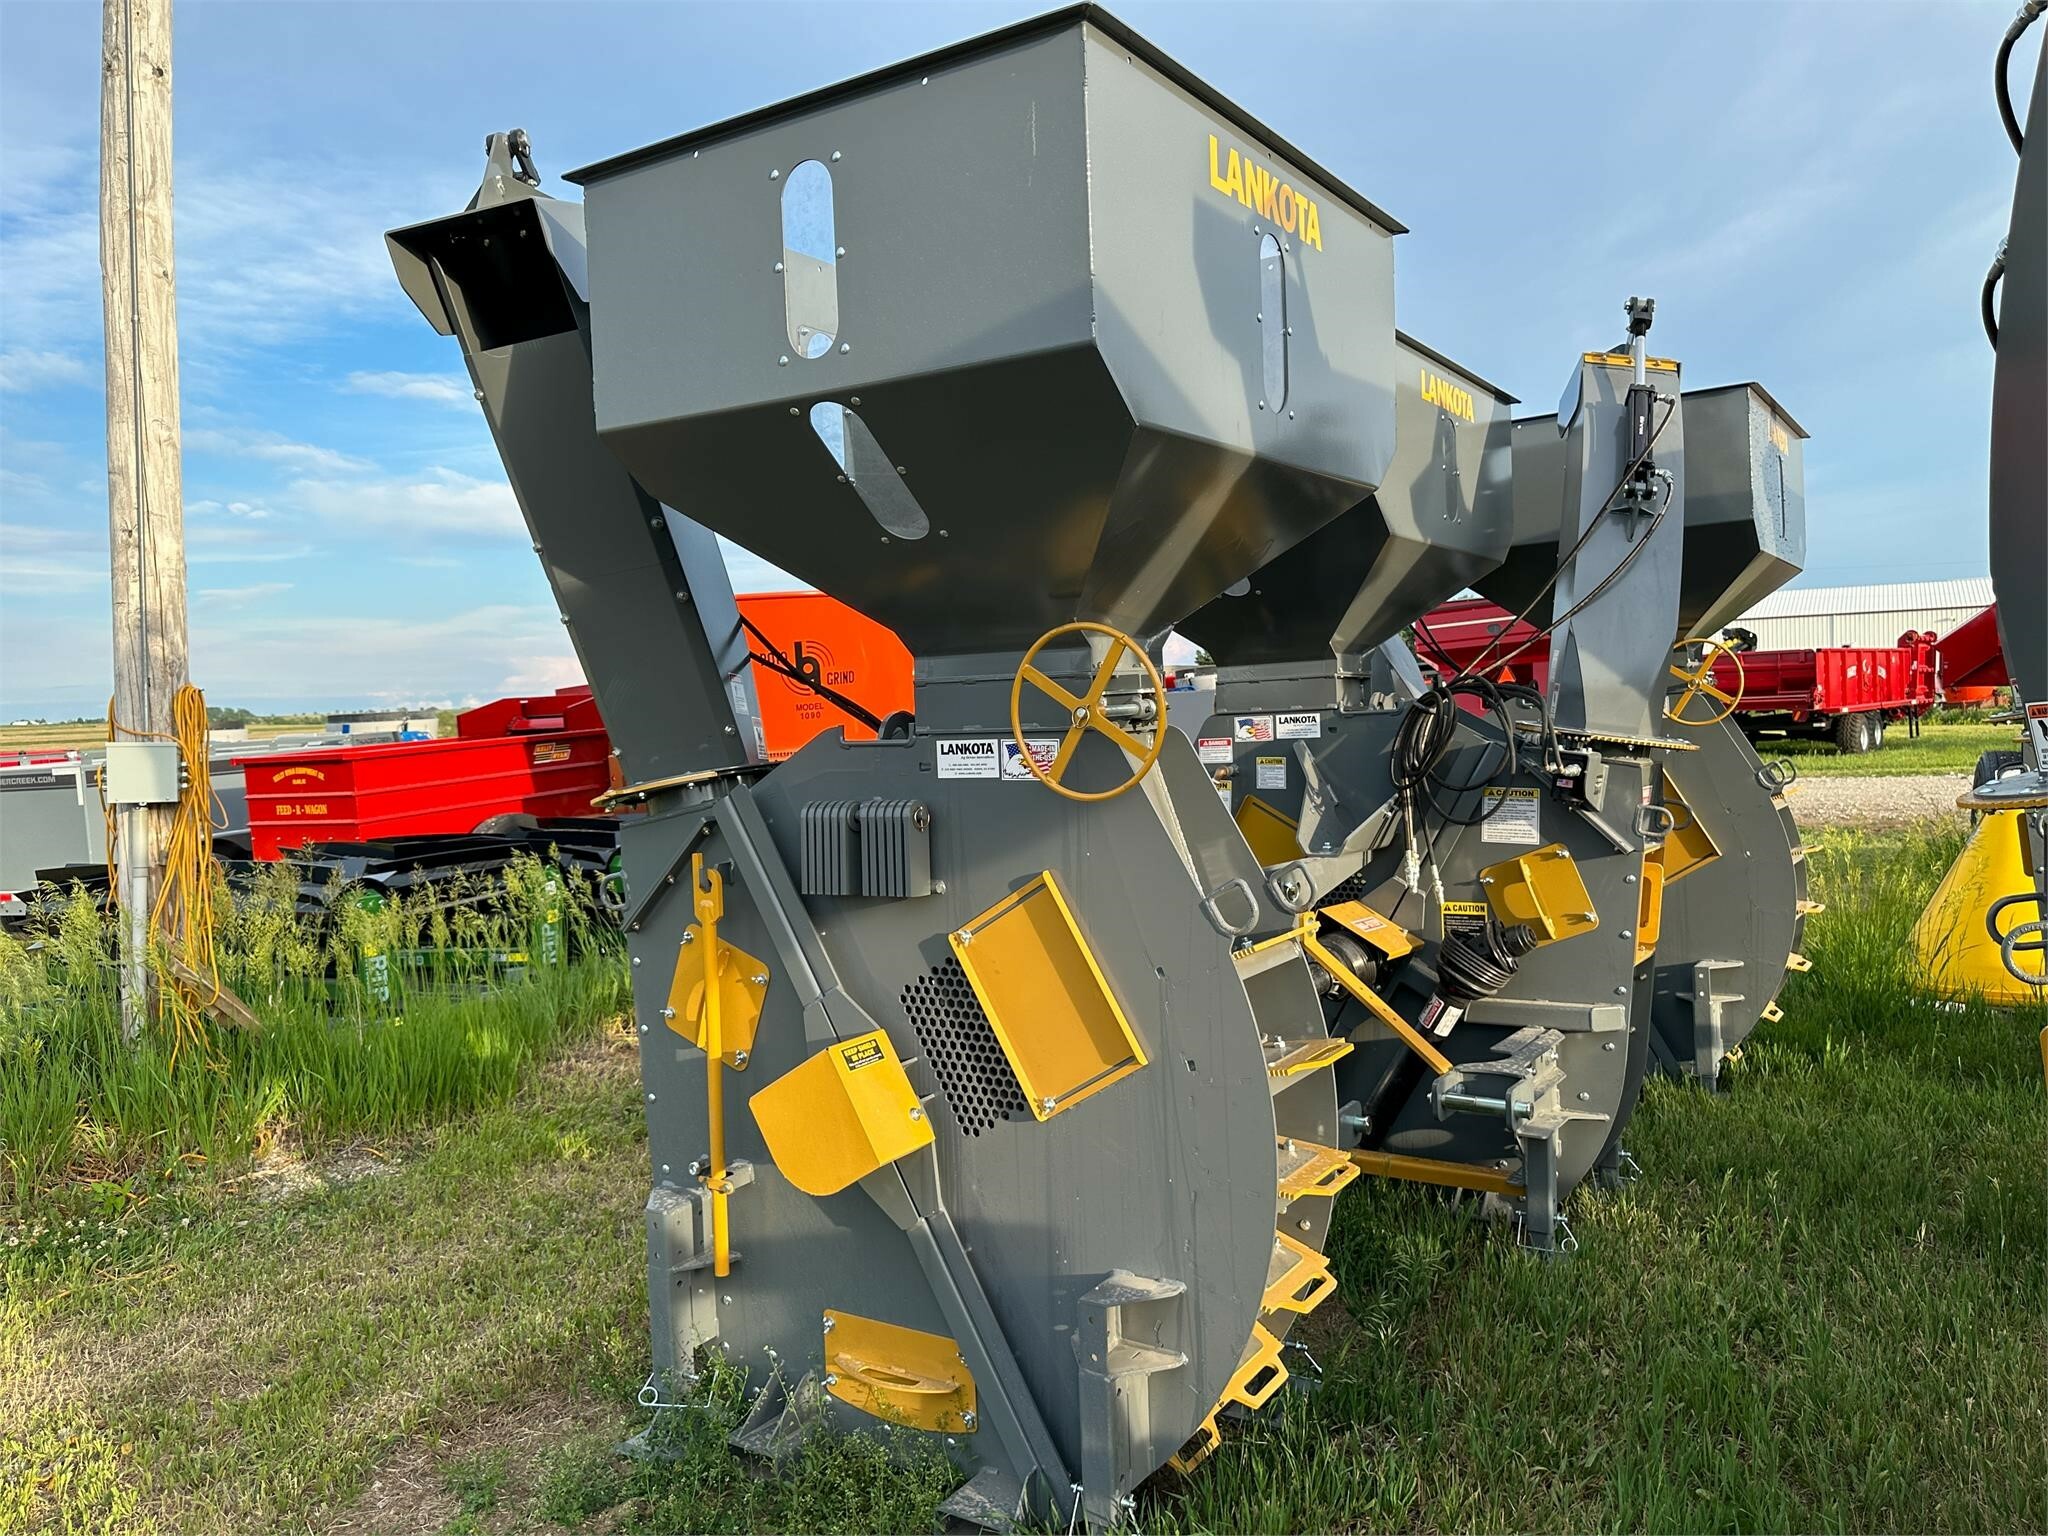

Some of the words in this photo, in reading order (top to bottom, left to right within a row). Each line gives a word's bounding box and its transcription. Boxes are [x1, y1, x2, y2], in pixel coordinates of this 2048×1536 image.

[1209, 134, 1322, 252] LANKOTA
[1421, 368, 1474, 424] LANKOTA
[826, 670, 855, 686] GRIND
[796, 702, 824, 712] MODEL
[801, 711, 821, 720] 1090
[1279, 716, 1316, 724] LANKOTA
[940, 743, 994, 755] LANKOTA
[1452, 904, 1485, 912] CAUTION
